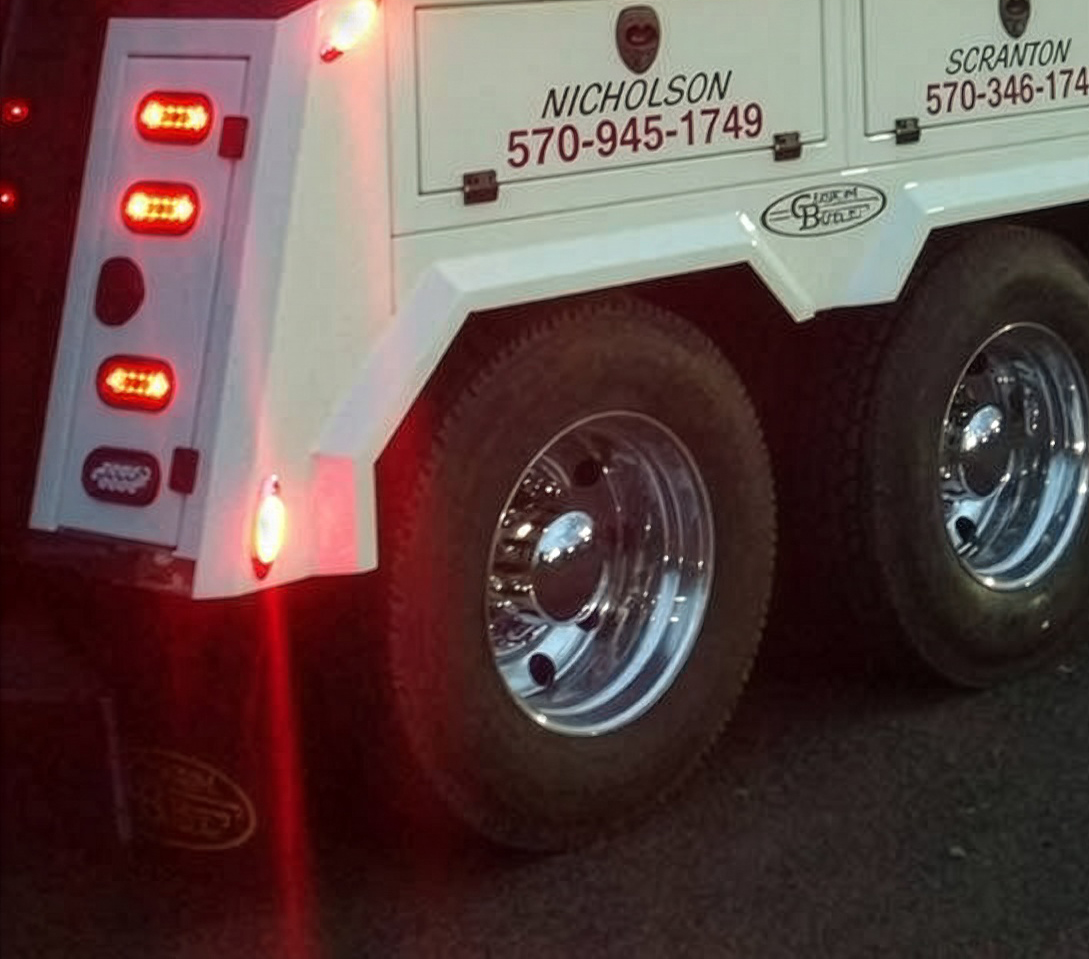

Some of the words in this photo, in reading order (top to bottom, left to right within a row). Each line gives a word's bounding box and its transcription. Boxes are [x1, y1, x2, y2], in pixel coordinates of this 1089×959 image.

[945, 38, 1073, 75] SCRANTON
[541, 70, 733, 119] NICHOLSON
[507, 103, 763, 168] 570-945-1749
